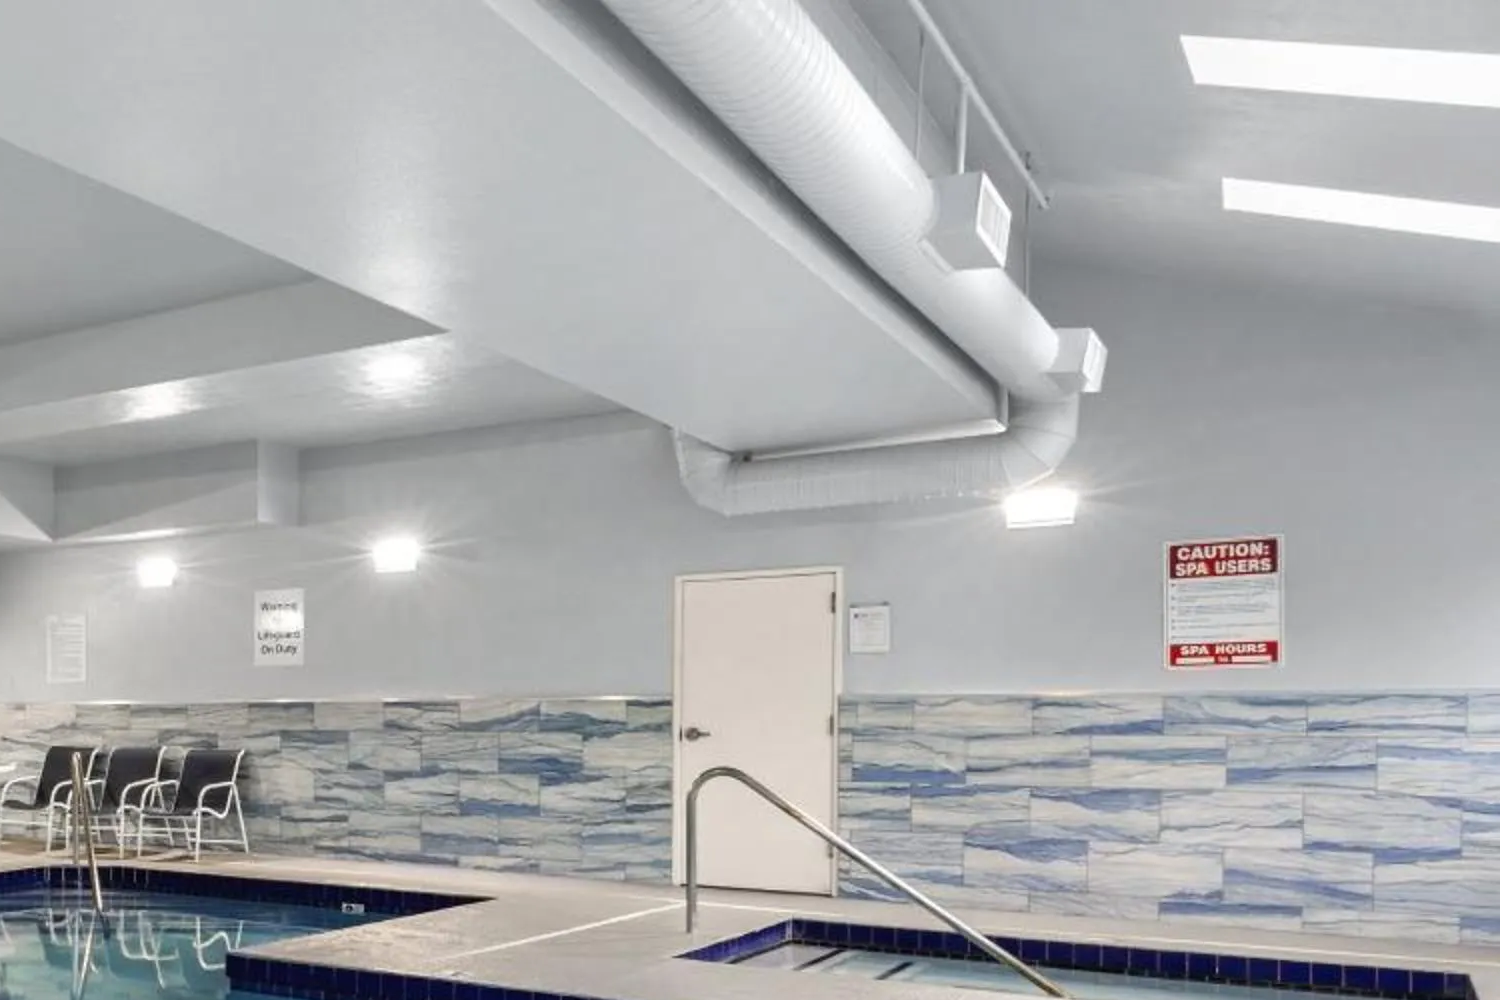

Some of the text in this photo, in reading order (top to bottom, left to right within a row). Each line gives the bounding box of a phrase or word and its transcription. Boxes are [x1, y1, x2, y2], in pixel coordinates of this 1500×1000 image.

[1177, 542, 1269, 560] CAUTION:
[1175, 558, 1272, 577] SPA USERS
[261, 643, 297, 656] On Duty
[1180, 643, 1267, 656] SPA HOURS
